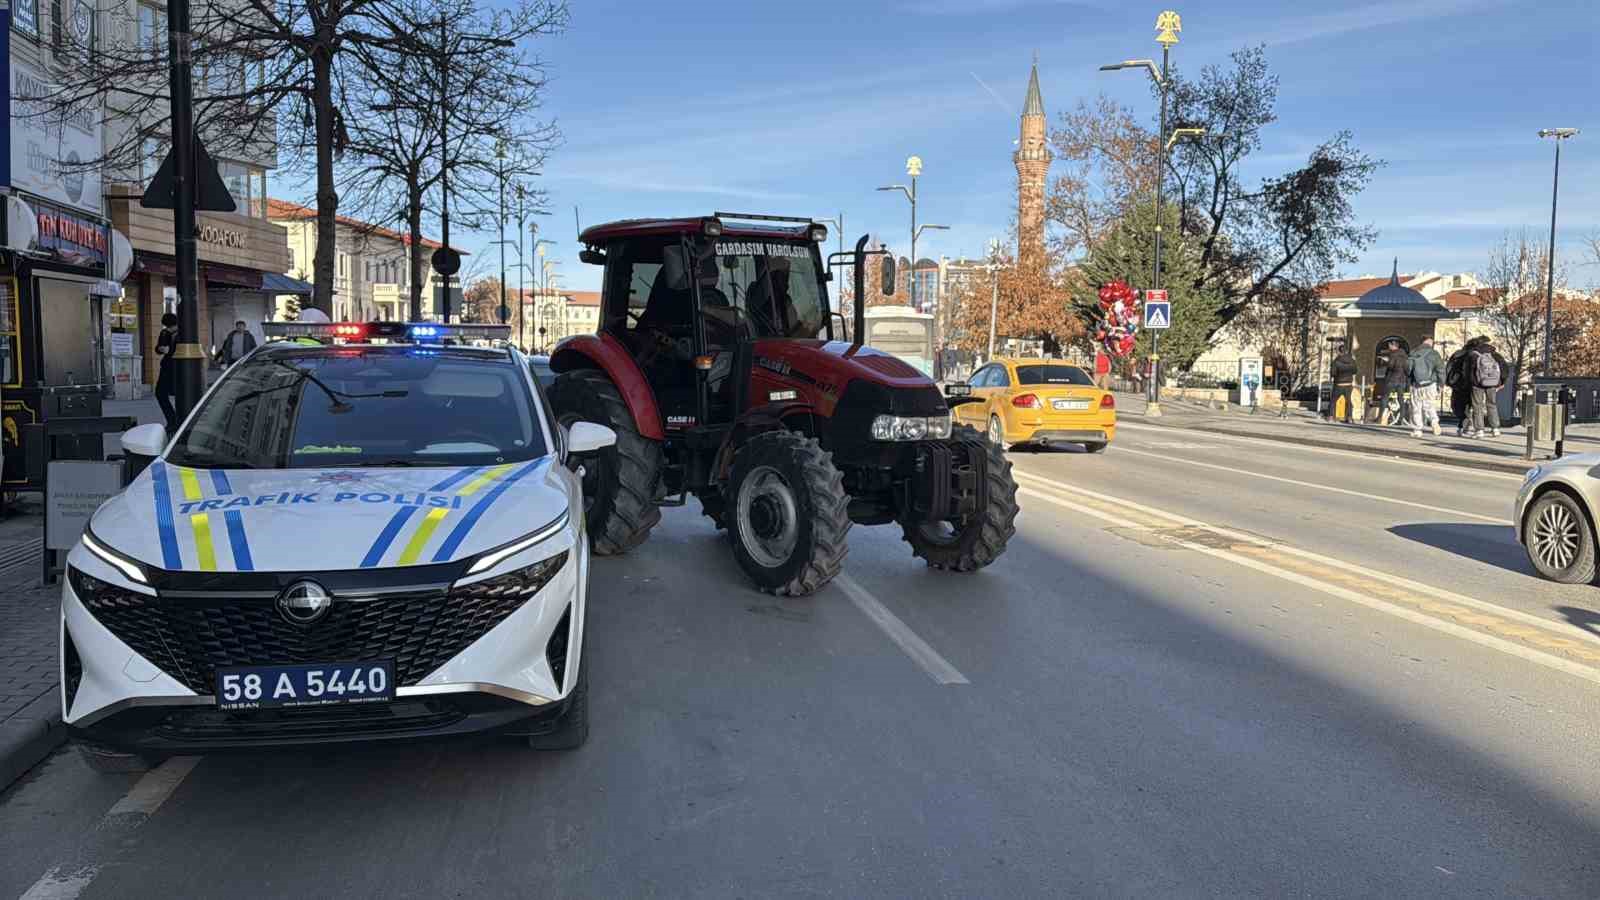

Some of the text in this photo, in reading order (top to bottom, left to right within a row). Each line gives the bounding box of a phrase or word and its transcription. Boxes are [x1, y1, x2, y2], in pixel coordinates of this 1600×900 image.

[223, 667, 386, 701] 58 A 5440
[221, 702, 260, 710] NISSAN
